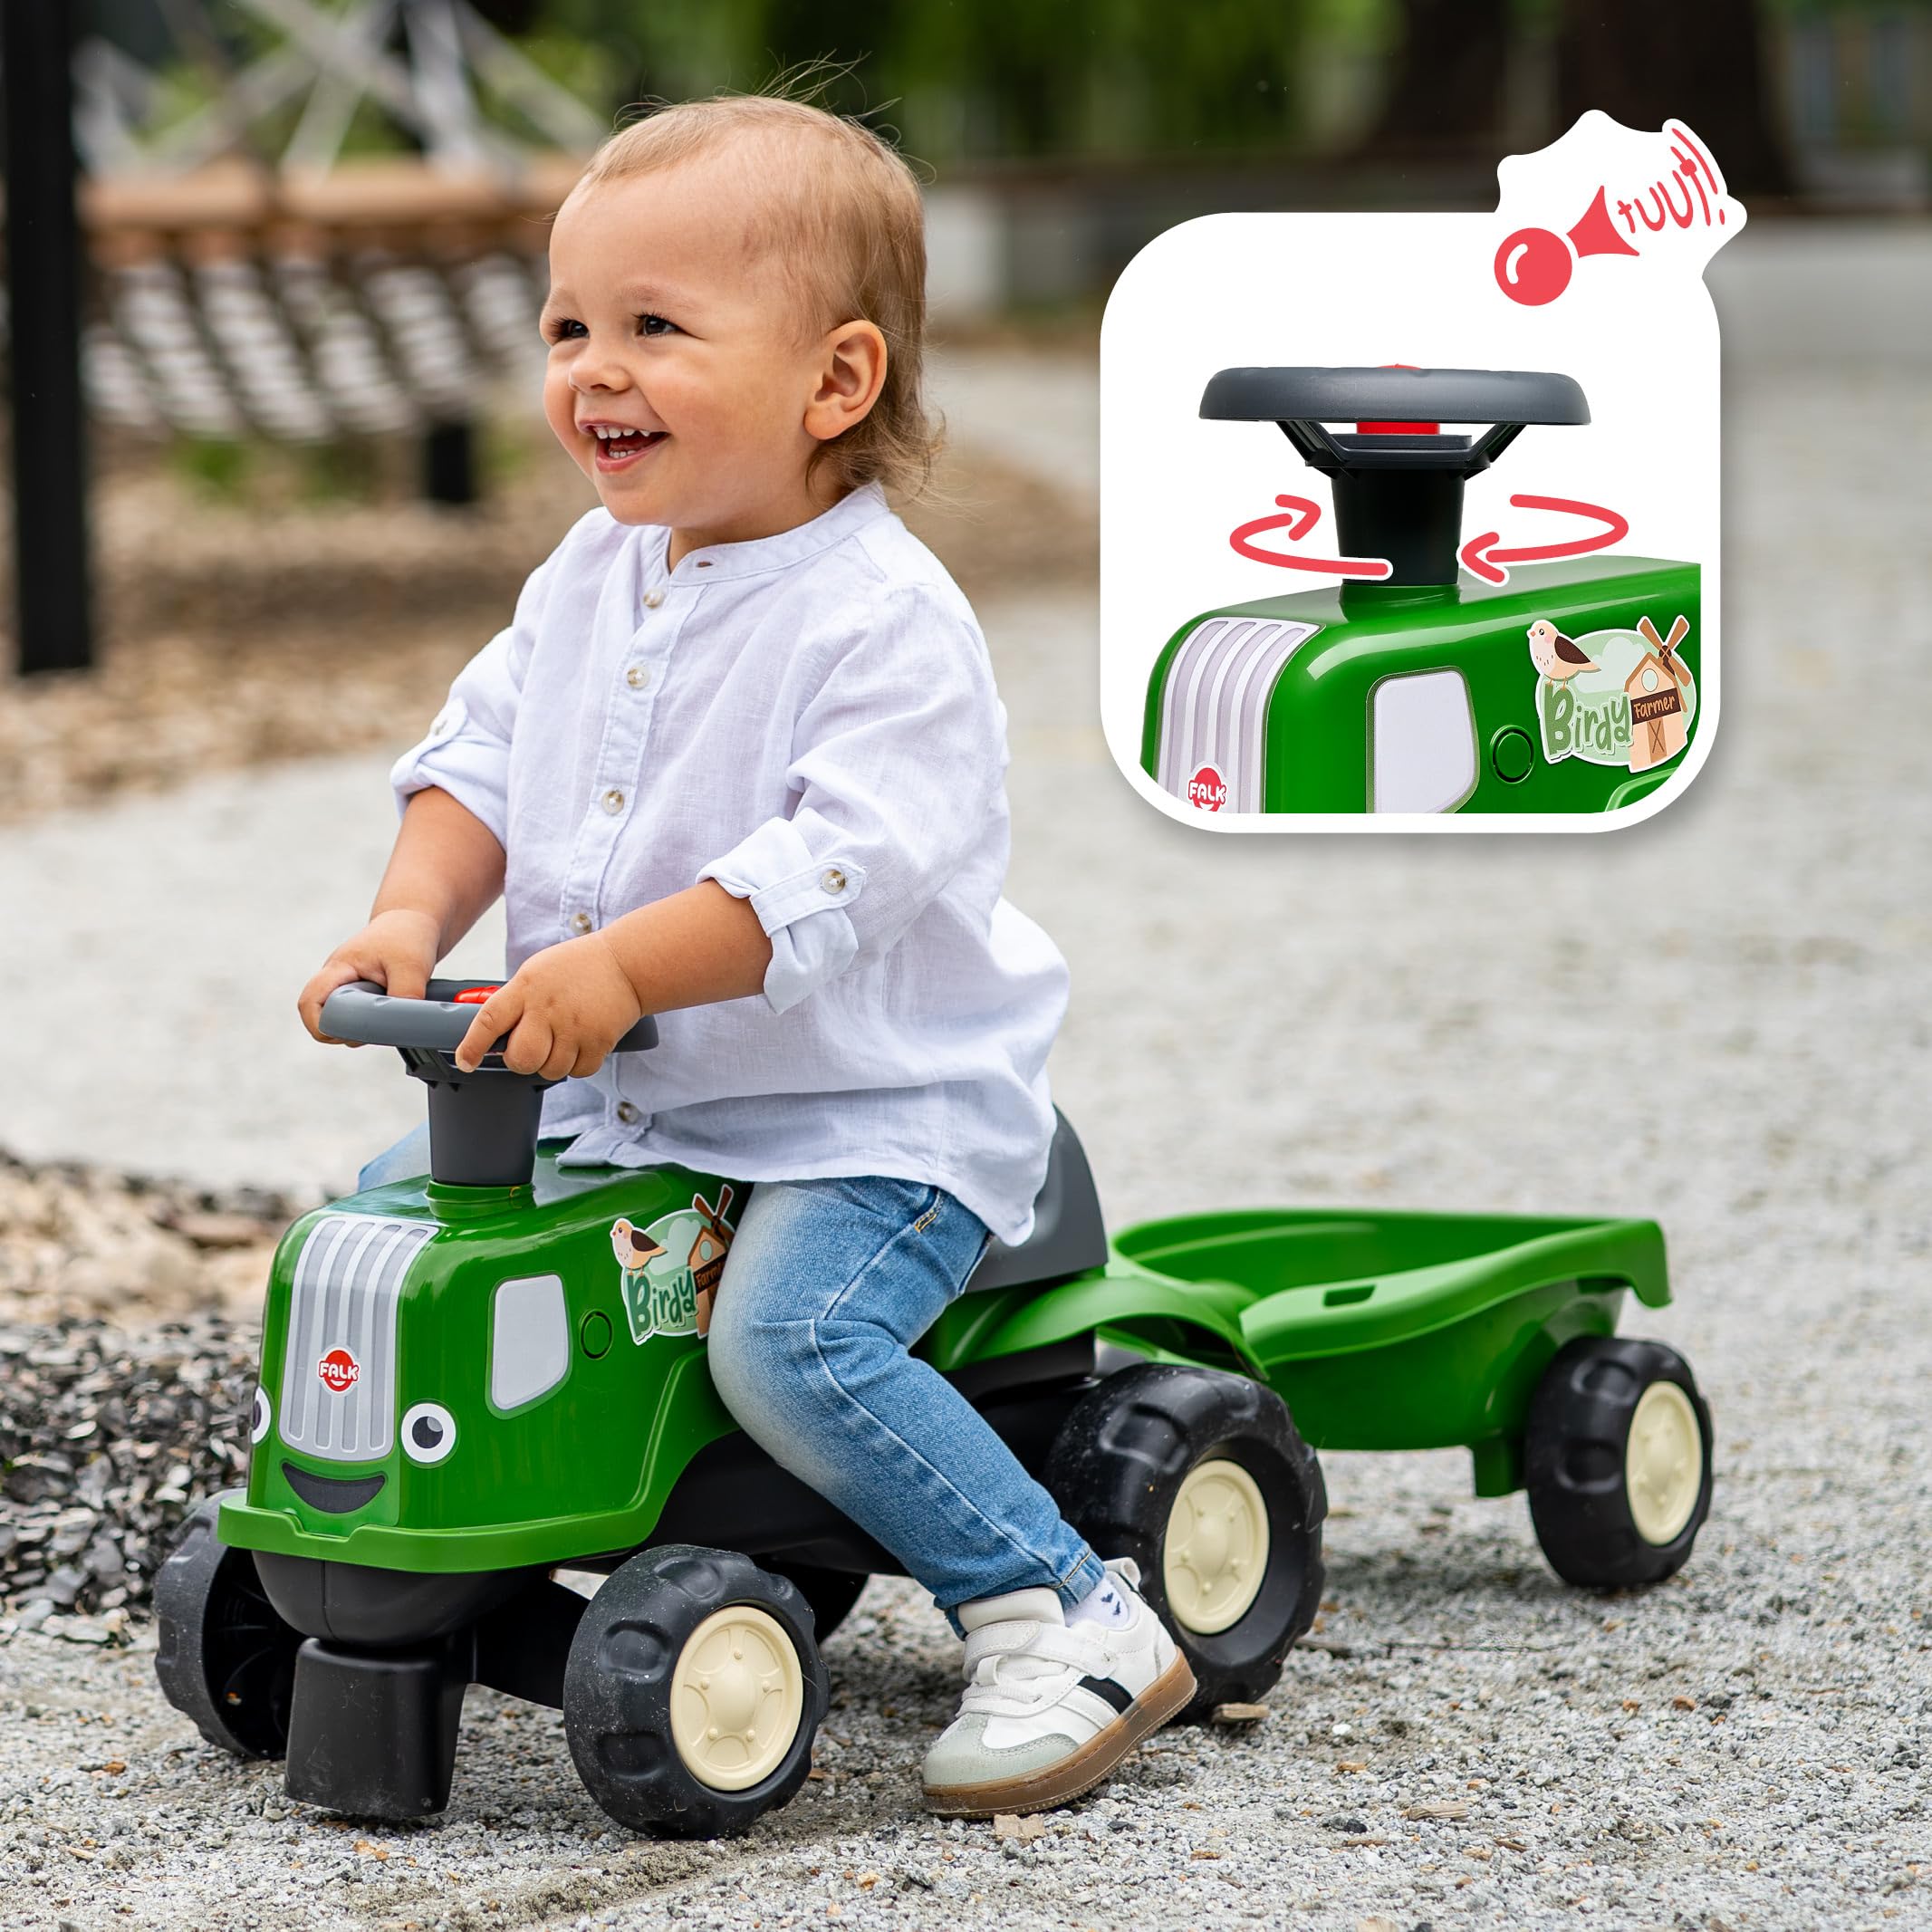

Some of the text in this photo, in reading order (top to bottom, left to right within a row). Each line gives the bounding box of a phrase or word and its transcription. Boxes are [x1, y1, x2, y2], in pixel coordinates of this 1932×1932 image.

[1544, 683, 1631, 755] Birdy
[1633, 696, 1675, 719] Farmer
[1188, 781, 1226, 804] FALK
[627, 1270, 697, 1338] Birdy
[320, 1361, 359, 1381] FALK
